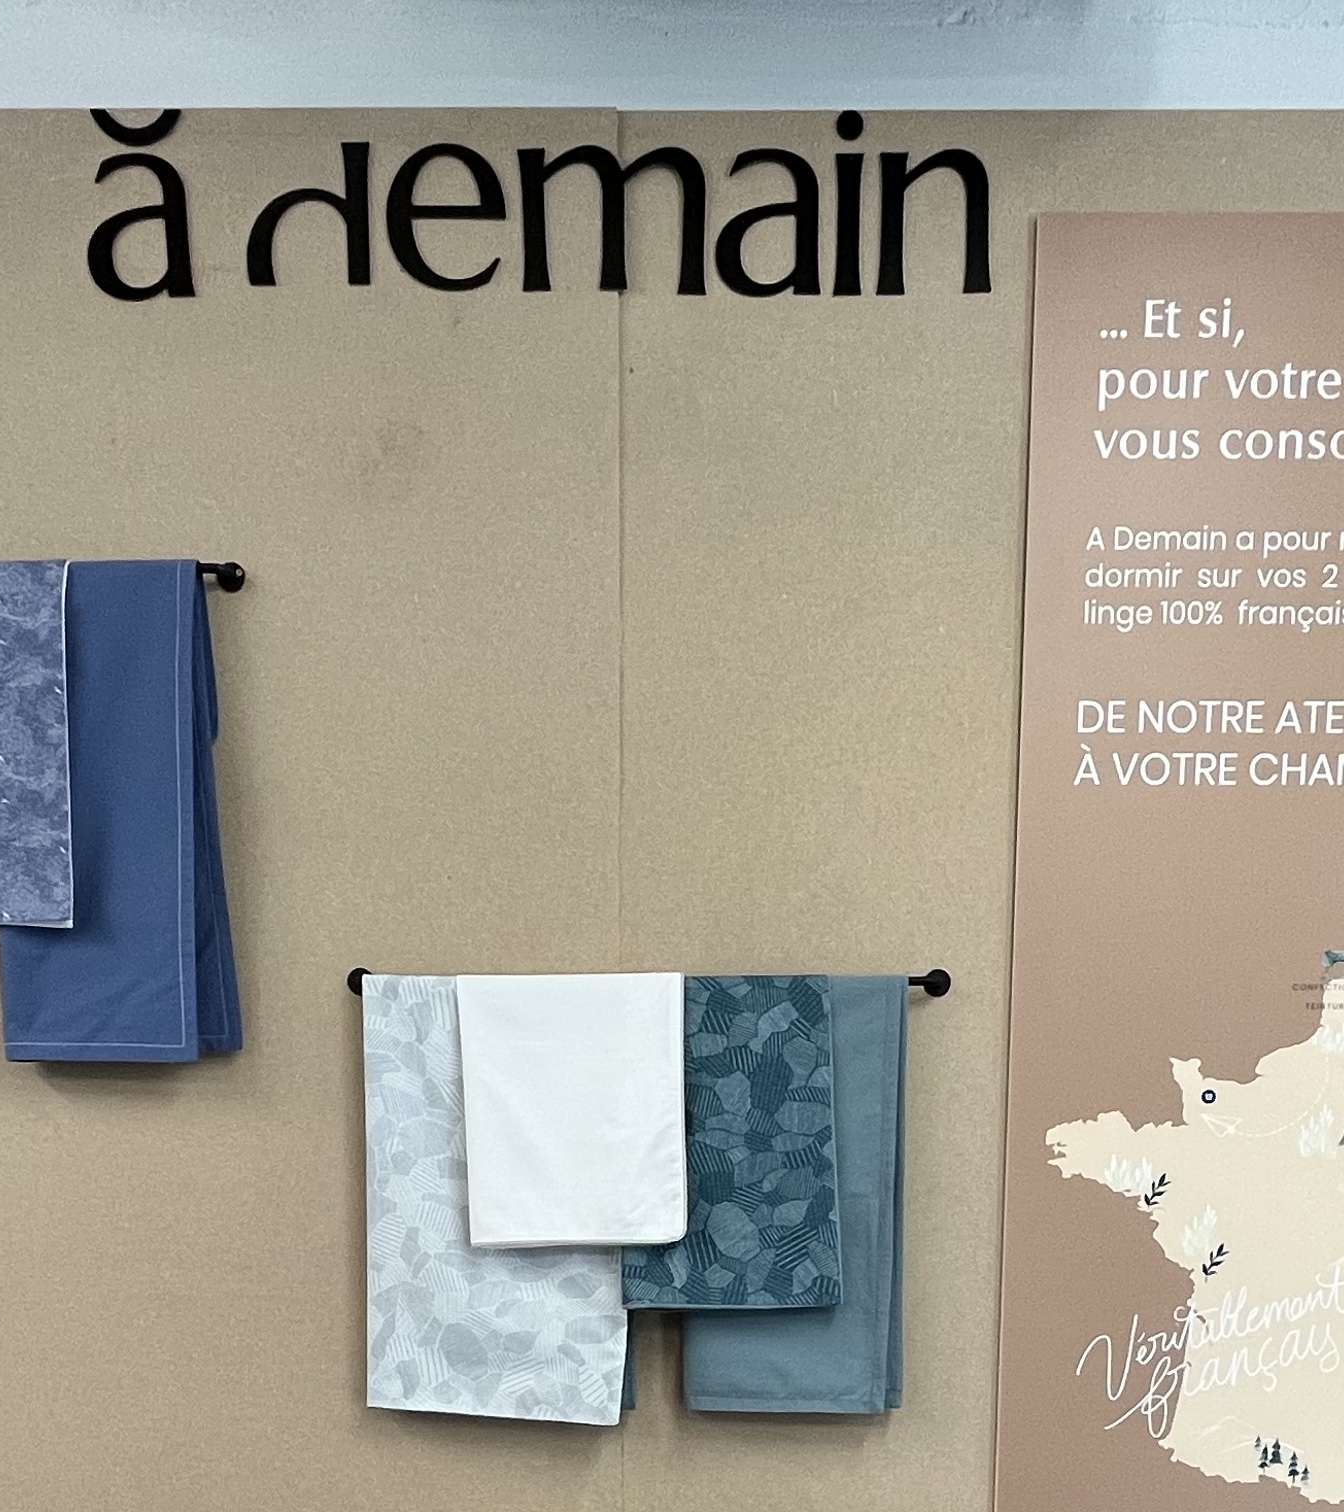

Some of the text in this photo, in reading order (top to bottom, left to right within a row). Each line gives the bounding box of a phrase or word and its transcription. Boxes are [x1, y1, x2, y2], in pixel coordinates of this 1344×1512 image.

[1144, 299, 1184, 340] Et
[1198, 297, 1247, 349] si,
[1098, 368, 1210, 413] pour
[1225, 362, 1344, 402] votre
[1093, 429, 1202, 461] vous
[1086, 527, 1106, 552] A
[1114, 525, 1228, 553] Demain
[1235, 532, 1256, 553] a
[1263, 532, 1333, 560] pour
[1085, 562, 1184, 590] dormir
[1197, 568, 1244, 590] sur
[1256, 568, 1308, 590] vos
[1321, 563, 1340, 590] 2
[1083, 598, 1155, 634] linge
[1160, 600, 1225, 627] 100%
[1077, 700, 1127, 735] DE
[1138, 699, 1266, 736] NOTRE
[1073, 743, 1103, 787] À
[1112, 752, 1241, 788] VOTRE
